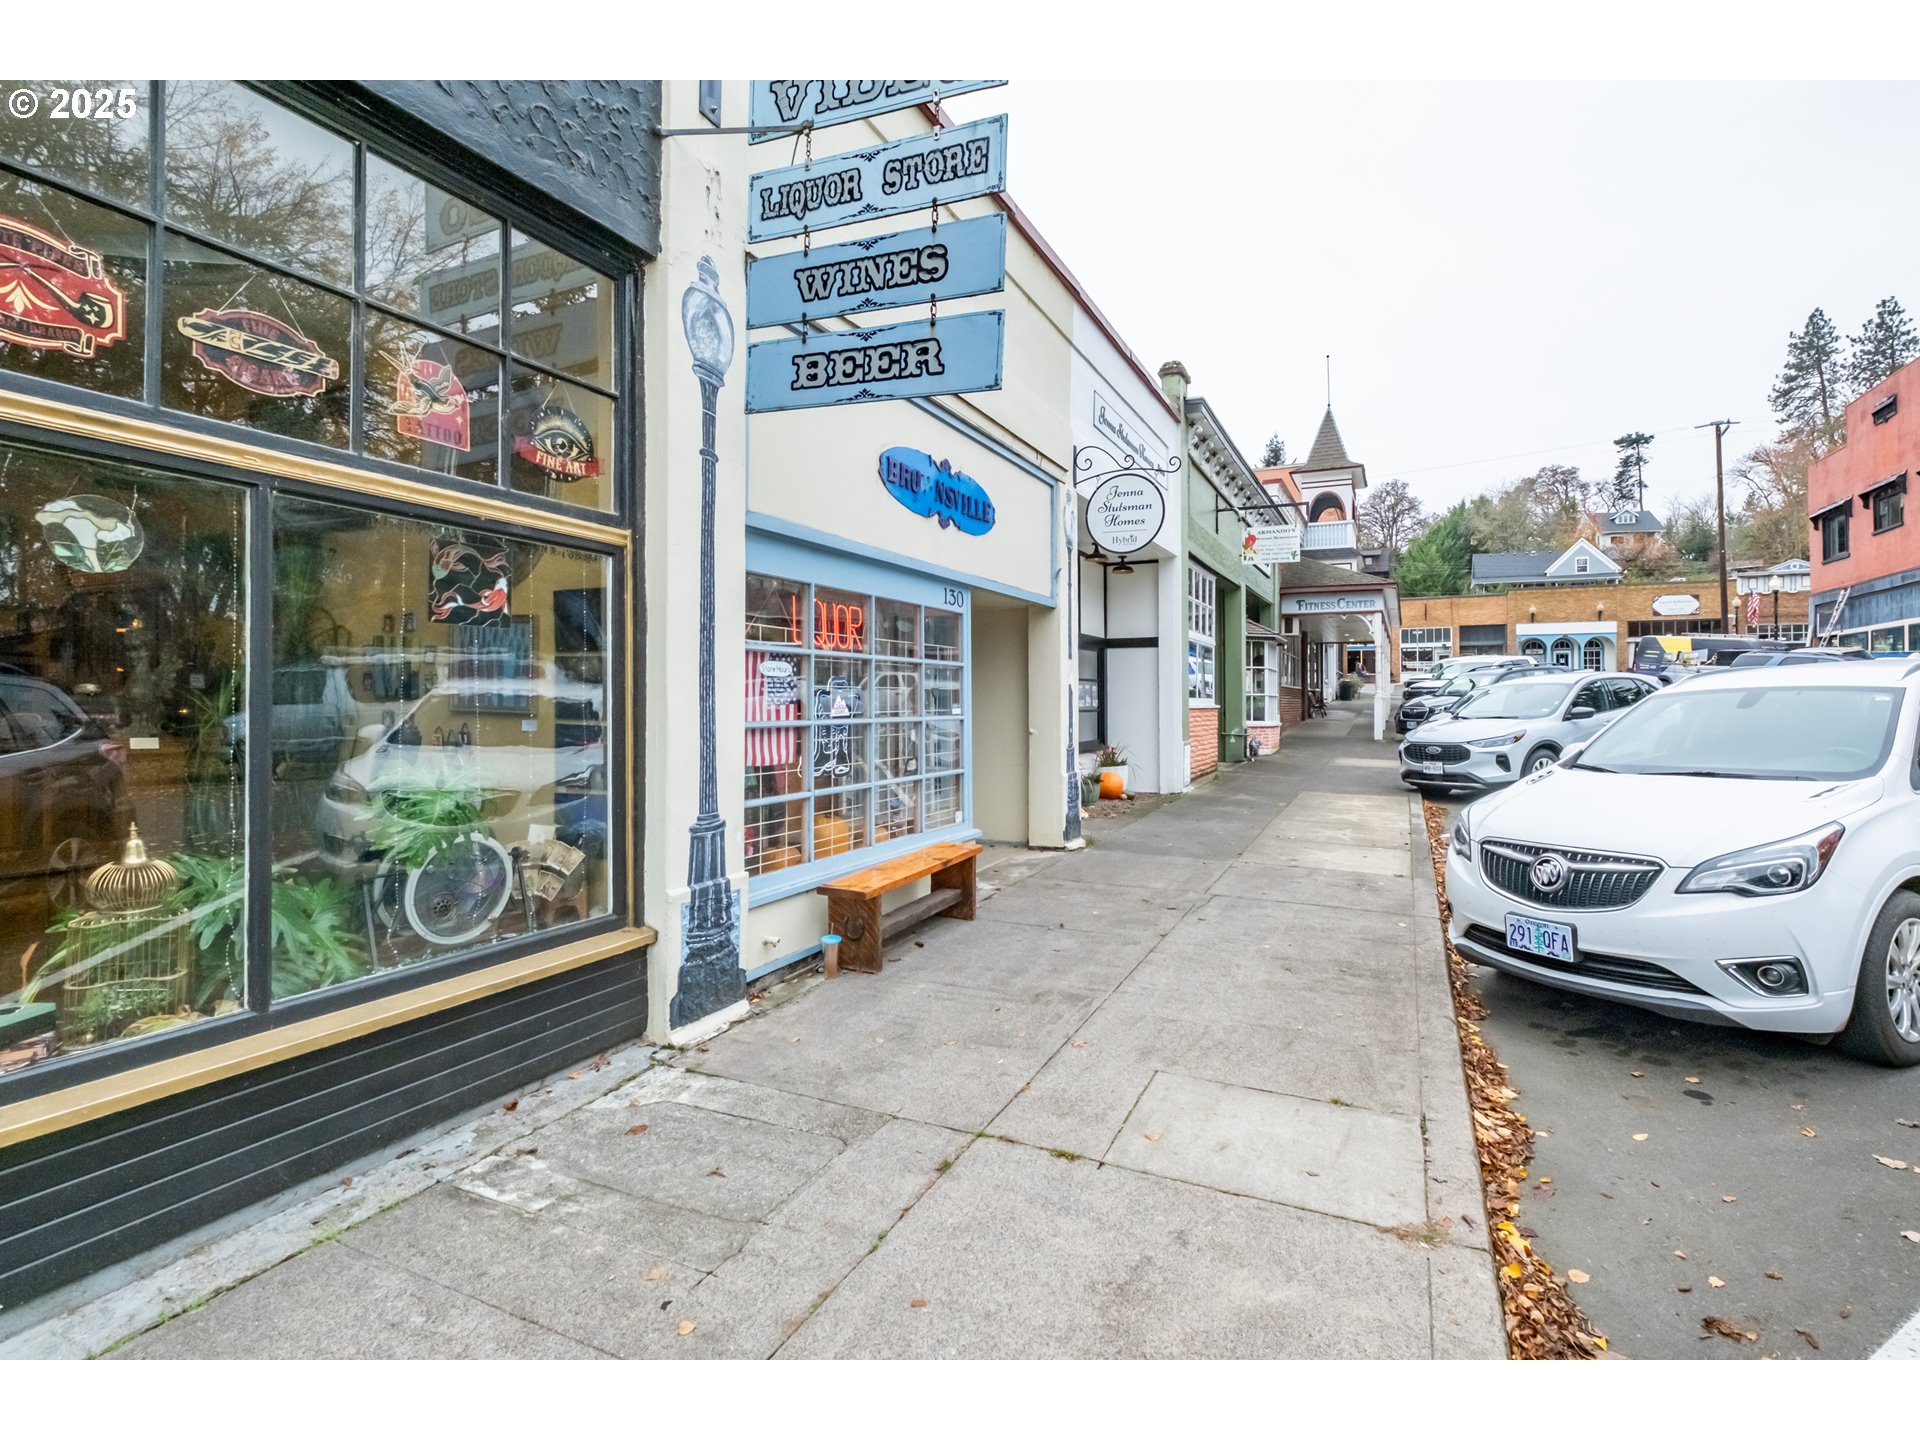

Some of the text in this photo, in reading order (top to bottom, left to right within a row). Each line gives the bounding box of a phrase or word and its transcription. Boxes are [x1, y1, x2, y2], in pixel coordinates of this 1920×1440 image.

[761, 136, 991, 222] LIQUOR STORE
[794, 243, 949, 303] WINES
[791, 337, 944, 391] BEER
[535, 450, 588, 476] FINE ART
[1106, 485, 1144, 501] Jenna
[1098, 500, 1153, 514] Stutsman
[1104, 513, 1146, 528] Homes
[1112, 534, 1138, 546] Hybrid
[943, 587, 965, 609] 130
[1296, 597, 1377, 612] FITNESS CENTER
[791, 594, 864, 650] LQUOR
[1525, 919, 1550, 929] Oregon
[1509, 923, 1570, 954] 291 QFA
